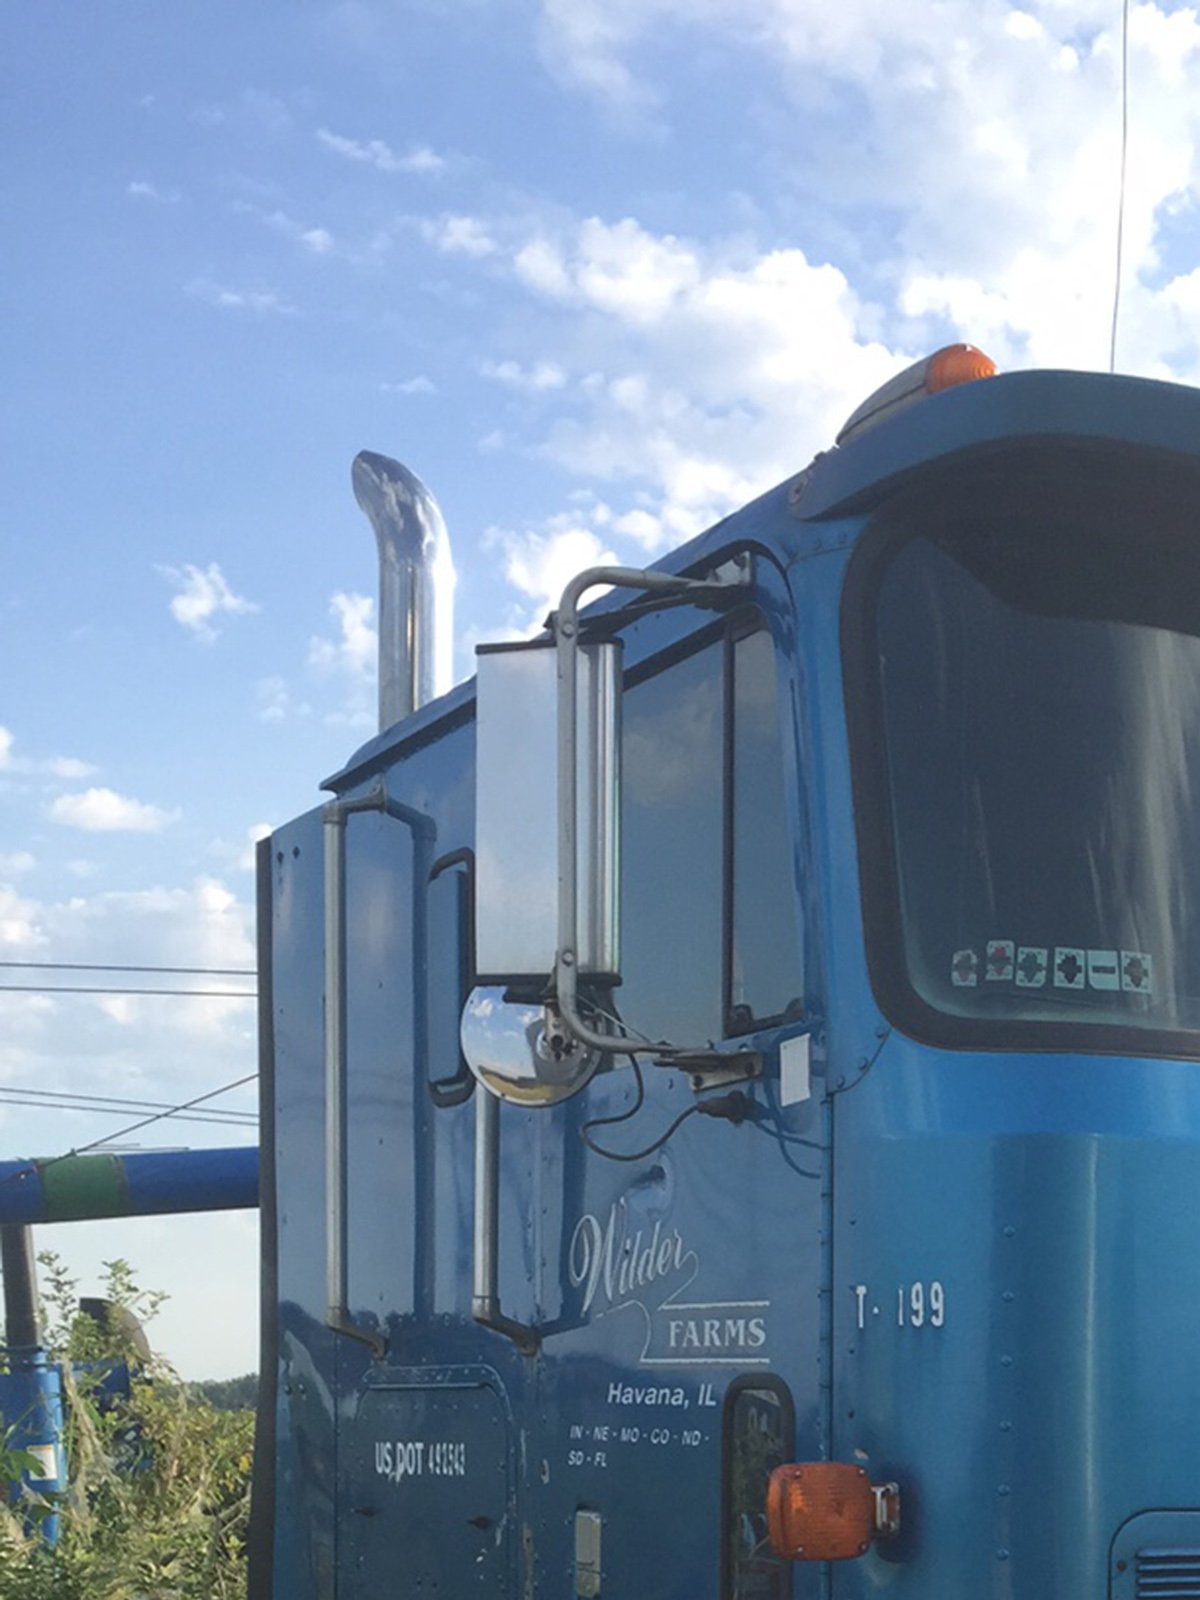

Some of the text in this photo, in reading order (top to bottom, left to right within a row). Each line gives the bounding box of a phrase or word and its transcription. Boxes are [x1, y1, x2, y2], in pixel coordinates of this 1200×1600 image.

[568, 1201, 698, 1317] Wilder
[668, 1318, 767, 1348] FARMS
[607, 1382, 717, 1410] Havana, IL
